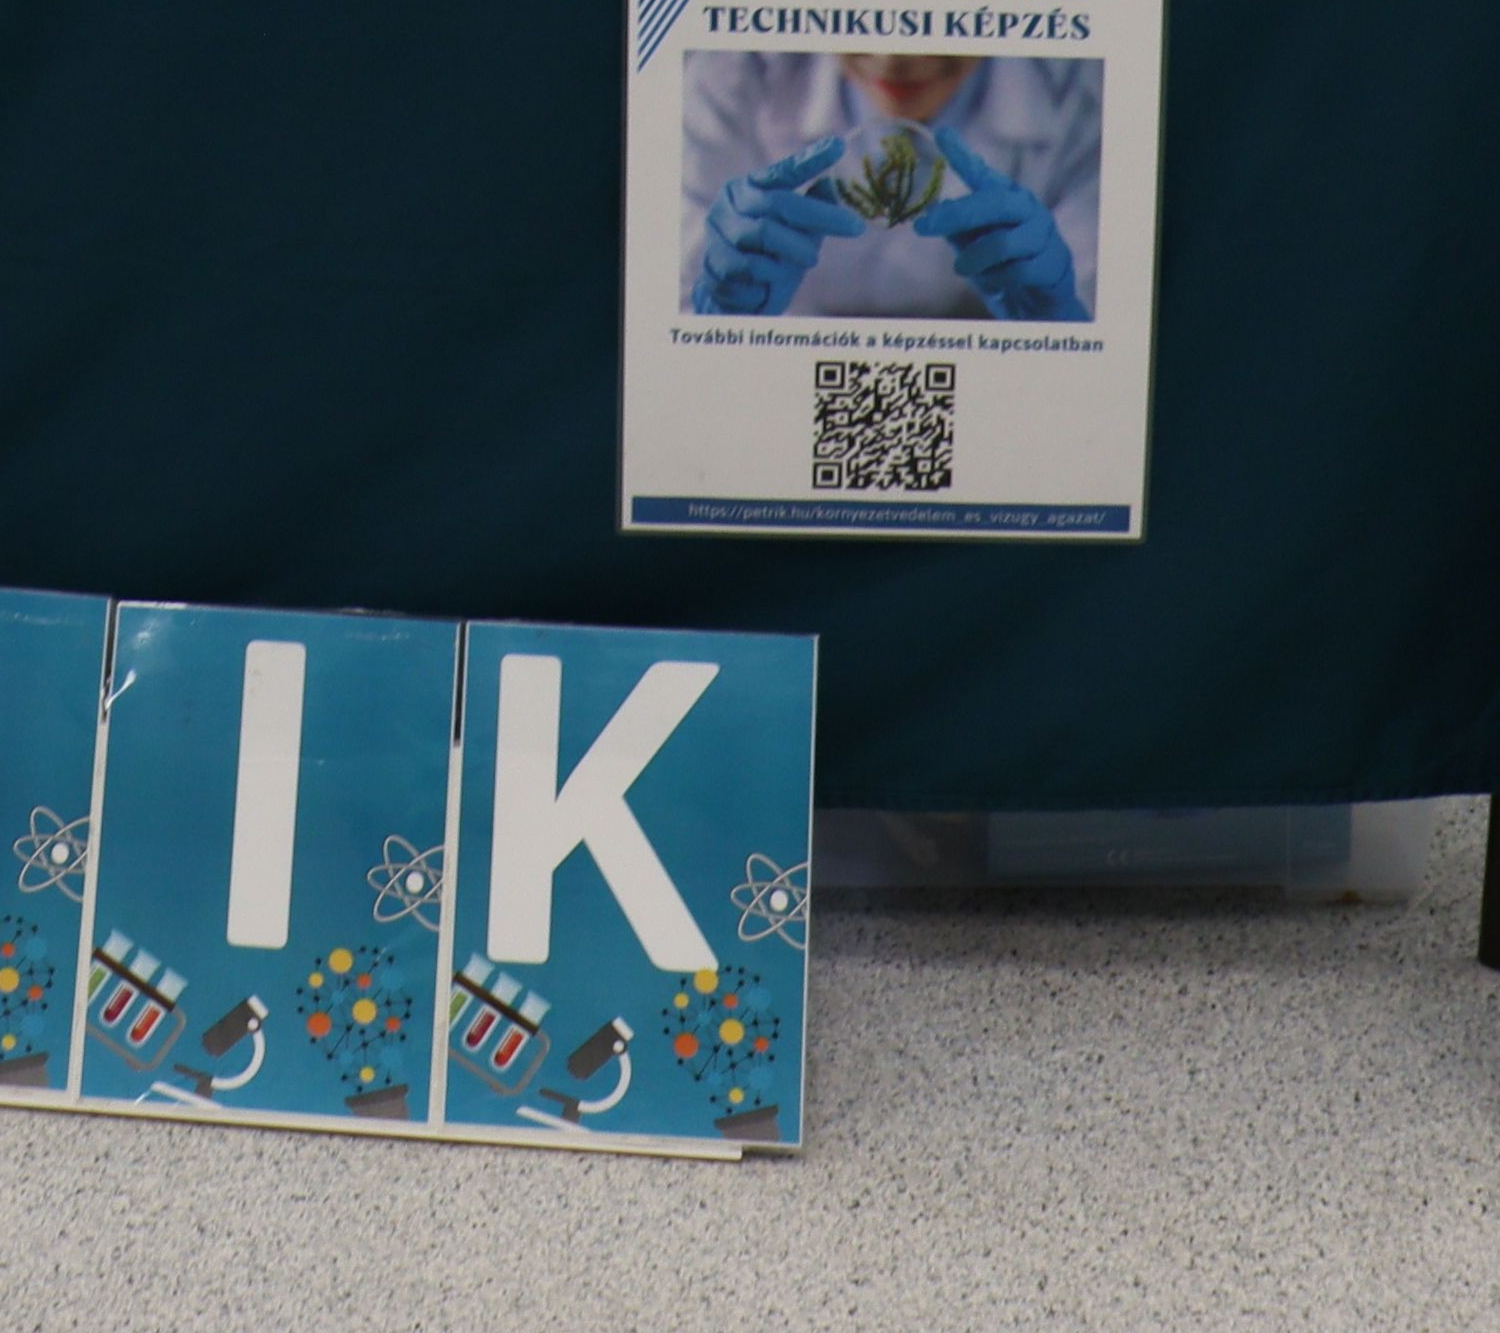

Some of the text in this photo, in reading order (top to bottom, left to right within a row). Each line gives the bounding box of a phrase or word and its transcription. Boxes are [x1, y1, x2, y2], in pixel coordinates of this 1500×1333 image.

[703, 6, 1091, 41] TECHNIKUSI KÉPZÉS
[670, 329, 744, 347] További
[866, 338, 876, 349] a
[882, 333, 973, 353] képzéssel
[978, 335, 1104, 355] kapcsolatban
